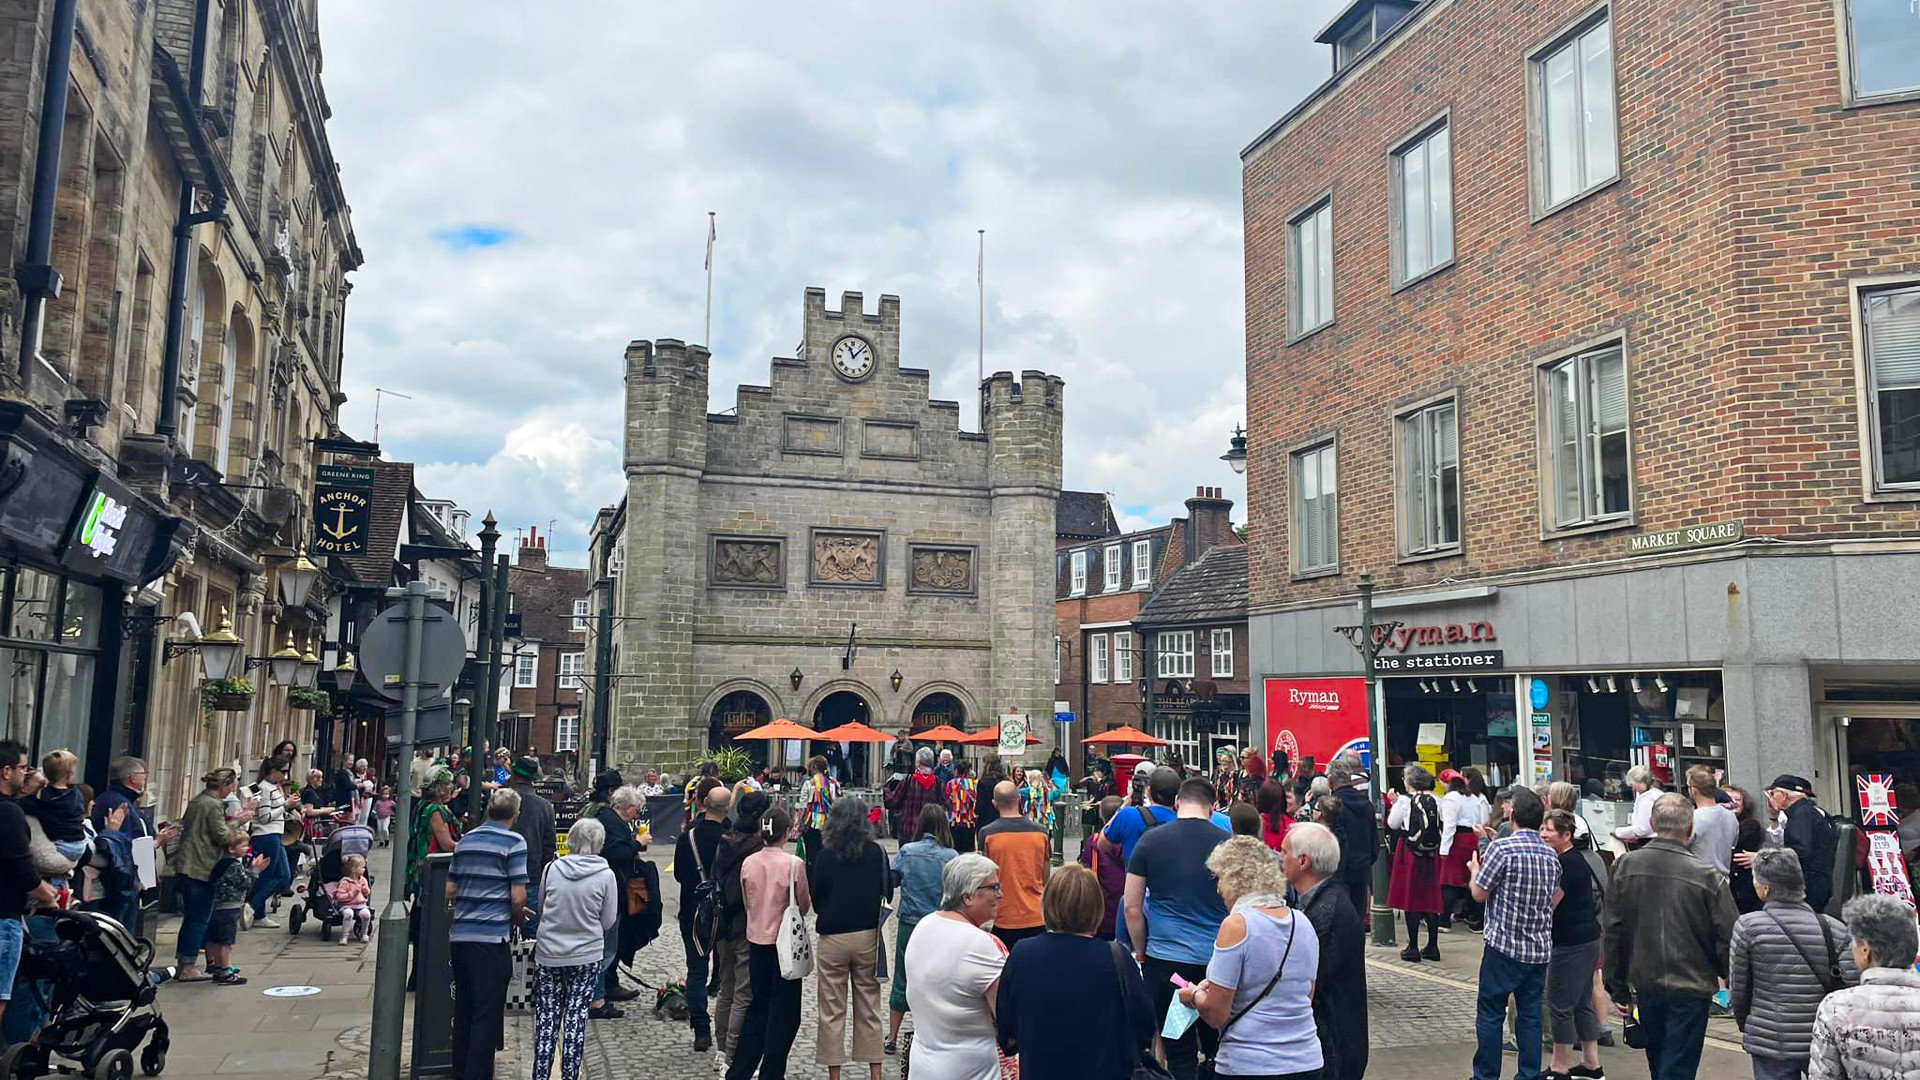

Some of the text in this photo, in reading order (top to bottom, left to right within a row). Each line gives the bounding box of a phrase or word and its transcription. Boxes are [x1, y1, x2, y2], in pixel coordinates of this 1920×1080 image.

[320, 492, 366, 507] ANCHOR
[1631, 523, 1735, 550] MARKET SQUARE
[316, 538, 360, 552] HOTEL
[1374, 654, 1495, 670] the stationer
[1289, 688, 1339, 706] Ryman
[1874, 834, 1887, 842] Only
[1875, 841, 1890, 849] £1.99
